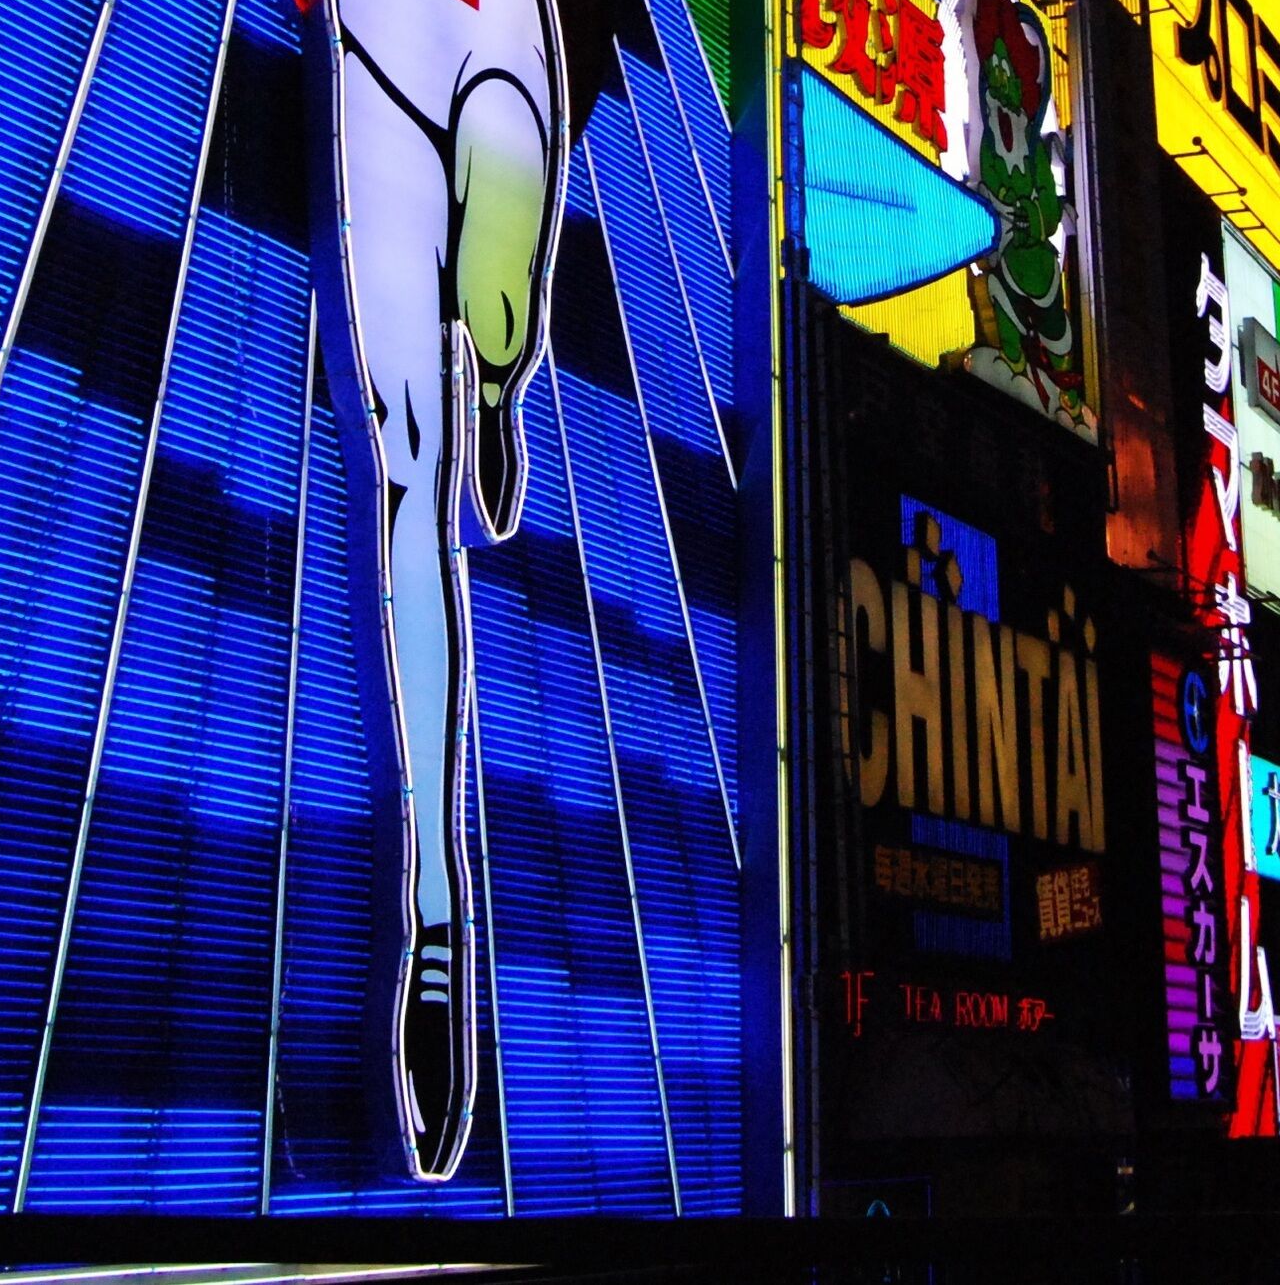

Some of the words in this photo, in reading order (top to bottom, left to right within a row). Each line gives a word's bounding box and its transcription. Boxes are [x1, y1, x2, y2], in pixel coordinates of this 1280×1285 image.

[1261, 367, 1280, 405] 4F
[838, 556, 1105, 854] CHINTAI
[1186, 762, 1222, 1094] エスカーサ
